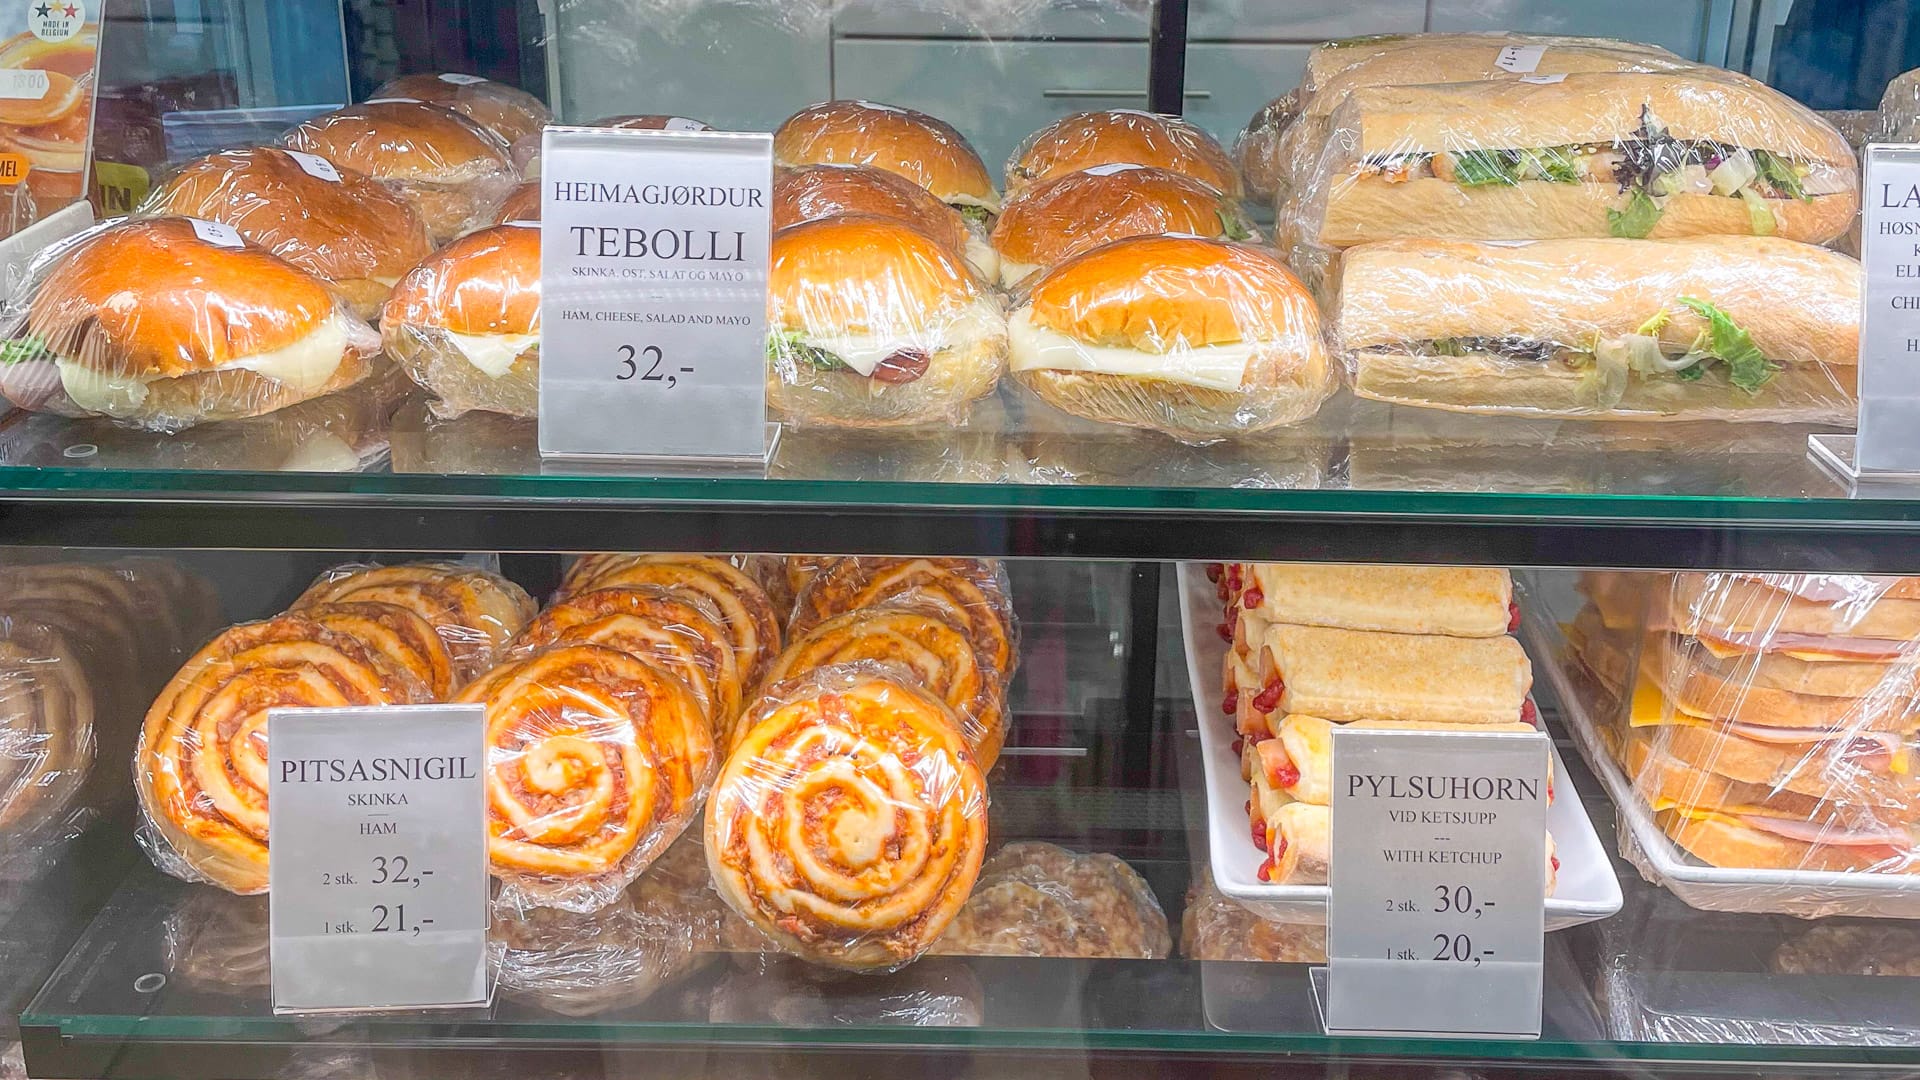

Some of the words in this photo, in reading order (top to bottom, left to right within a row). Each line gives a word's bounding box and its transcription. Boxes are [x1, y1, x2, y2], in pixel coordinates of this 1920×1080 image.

[41, 28, 69, 36] BELGIUM
[555, 182, 763, 207] HEIMAGJØRDUR
[570, 227, 745, 261] TEBOLLI
[649, 269, 687, 281] SALAT
[688, 270, 706, 281] OG
[708, 271, 744, 282] MAYO
[563, 309, 593, 322] HAM,
[596, 312, 643, 323] CHEESE,
[646, 313, 685, 323] SALAD
[687, 313, 713, 324] AND
[715, 315, 751, 326] MAYO
[615, 344, 694, 390] 32,-
[281, 757, 476, 782] PITSASNIGIL
[348, 793, 408, 806] SKINKA
[1348, 775, 1539, 800] PYLSUHORN
[359, 822, 397, 835] HAM
[1422, 811, 1496, 824] KETSJUPP
[1384, 850, 1423, 862] WITH
[1429, 851, 1502, 864] KETCHUP
[322, 872, 331, 886] 2
[334, 871, 358, 886] stk.
[372, 856, 433, 888] 32,-
[1385, 899, 1394, 912] 2
[1397, 899, 1421, 912] stk.
[1434, 885, 1495, 919] 30,-
[335, 920, 359, 934] stk.
[372, 904, 433, 936] 21,-
[1396, 947, 1420, 961] stk.
[1433, 934, 1494, 967] 20,-
